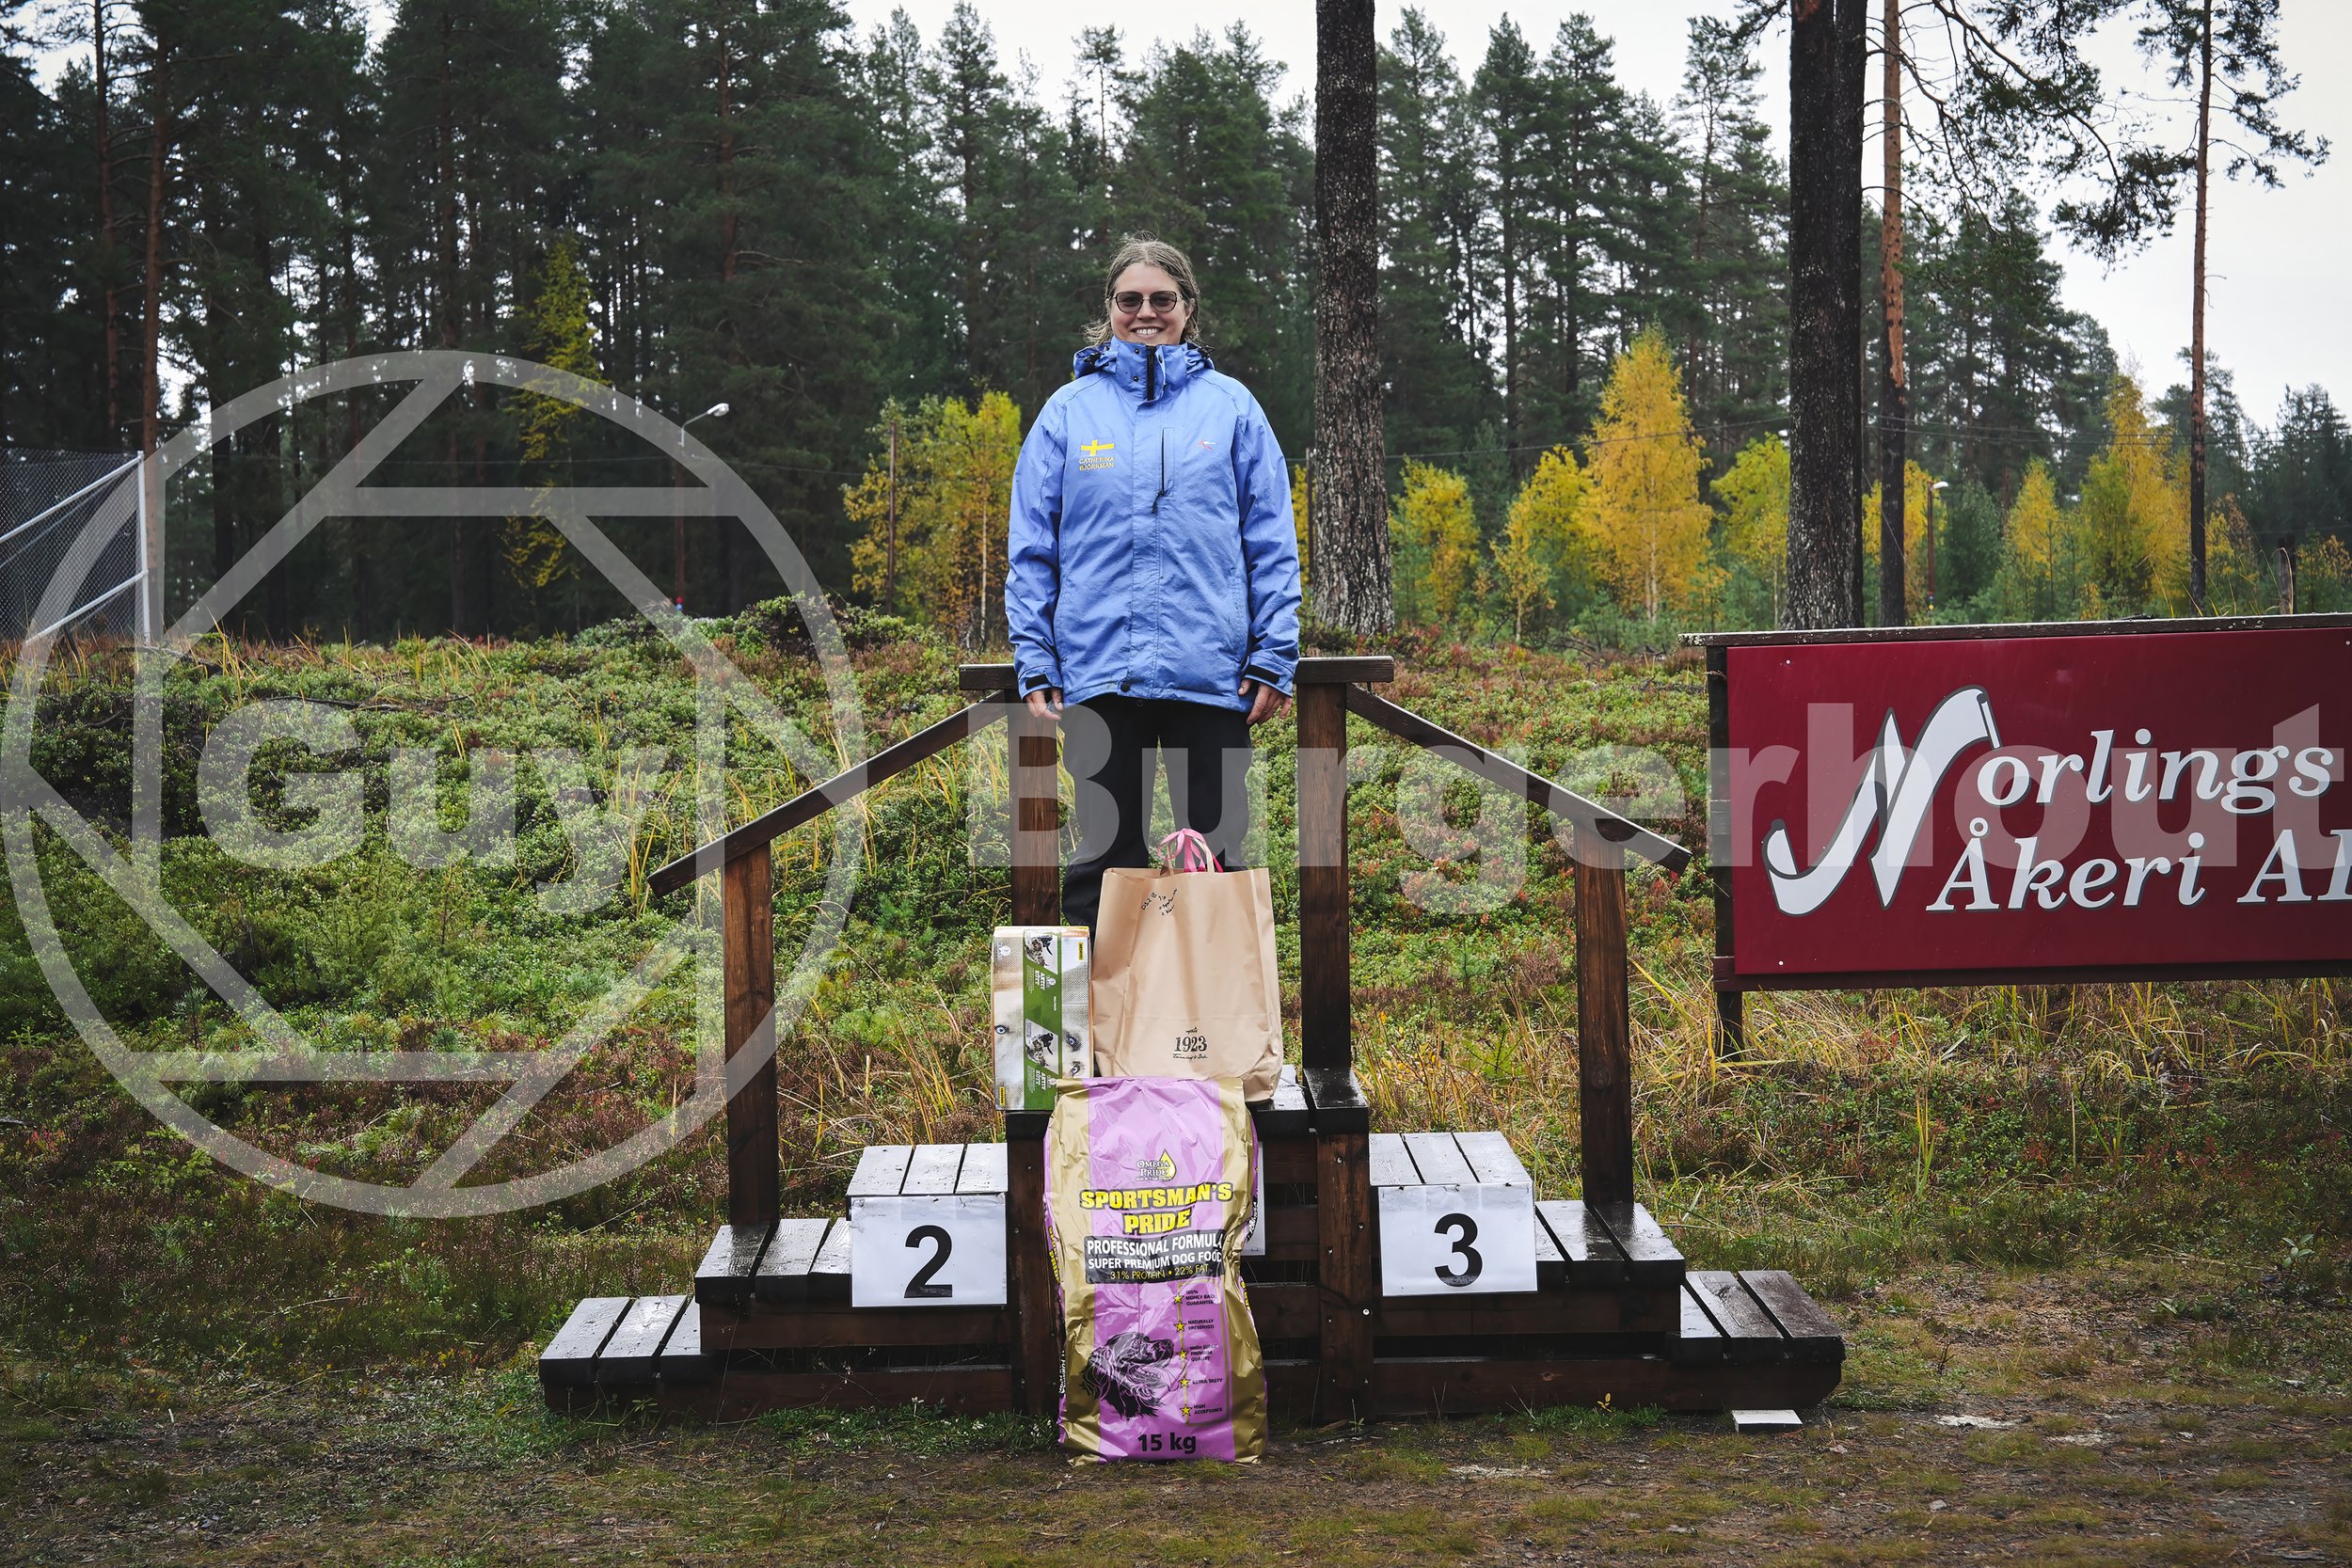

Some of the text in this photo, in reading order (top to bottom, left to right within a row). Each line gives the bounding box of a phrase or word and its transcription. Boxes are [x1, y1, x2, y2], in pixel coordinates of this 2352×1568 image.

[1762, 685, 2335, 916] Norlings
[1926, 817, 2206, 910] Åkeri
[1174, 1035, 1208, 1053] 1923
[1081, 1182, 1233, 1210] SPORTSMAN'S
[1123, 1209, 1192, 1234] PRIDE
[1087, 1239, 1169, 1257] PROFESSIONAL
[1088, 1250, 1222, 1270] SUPER PREMIUM DOG FOOD
[1434, 1212, 1483, 1288] 3
[904, 1225, 953, 1298] 2
[1110, 1263, 1209, 1279] 31% PROTEIN 22% FAT
[1137, 1432, 1197, 1454] 15 kg
